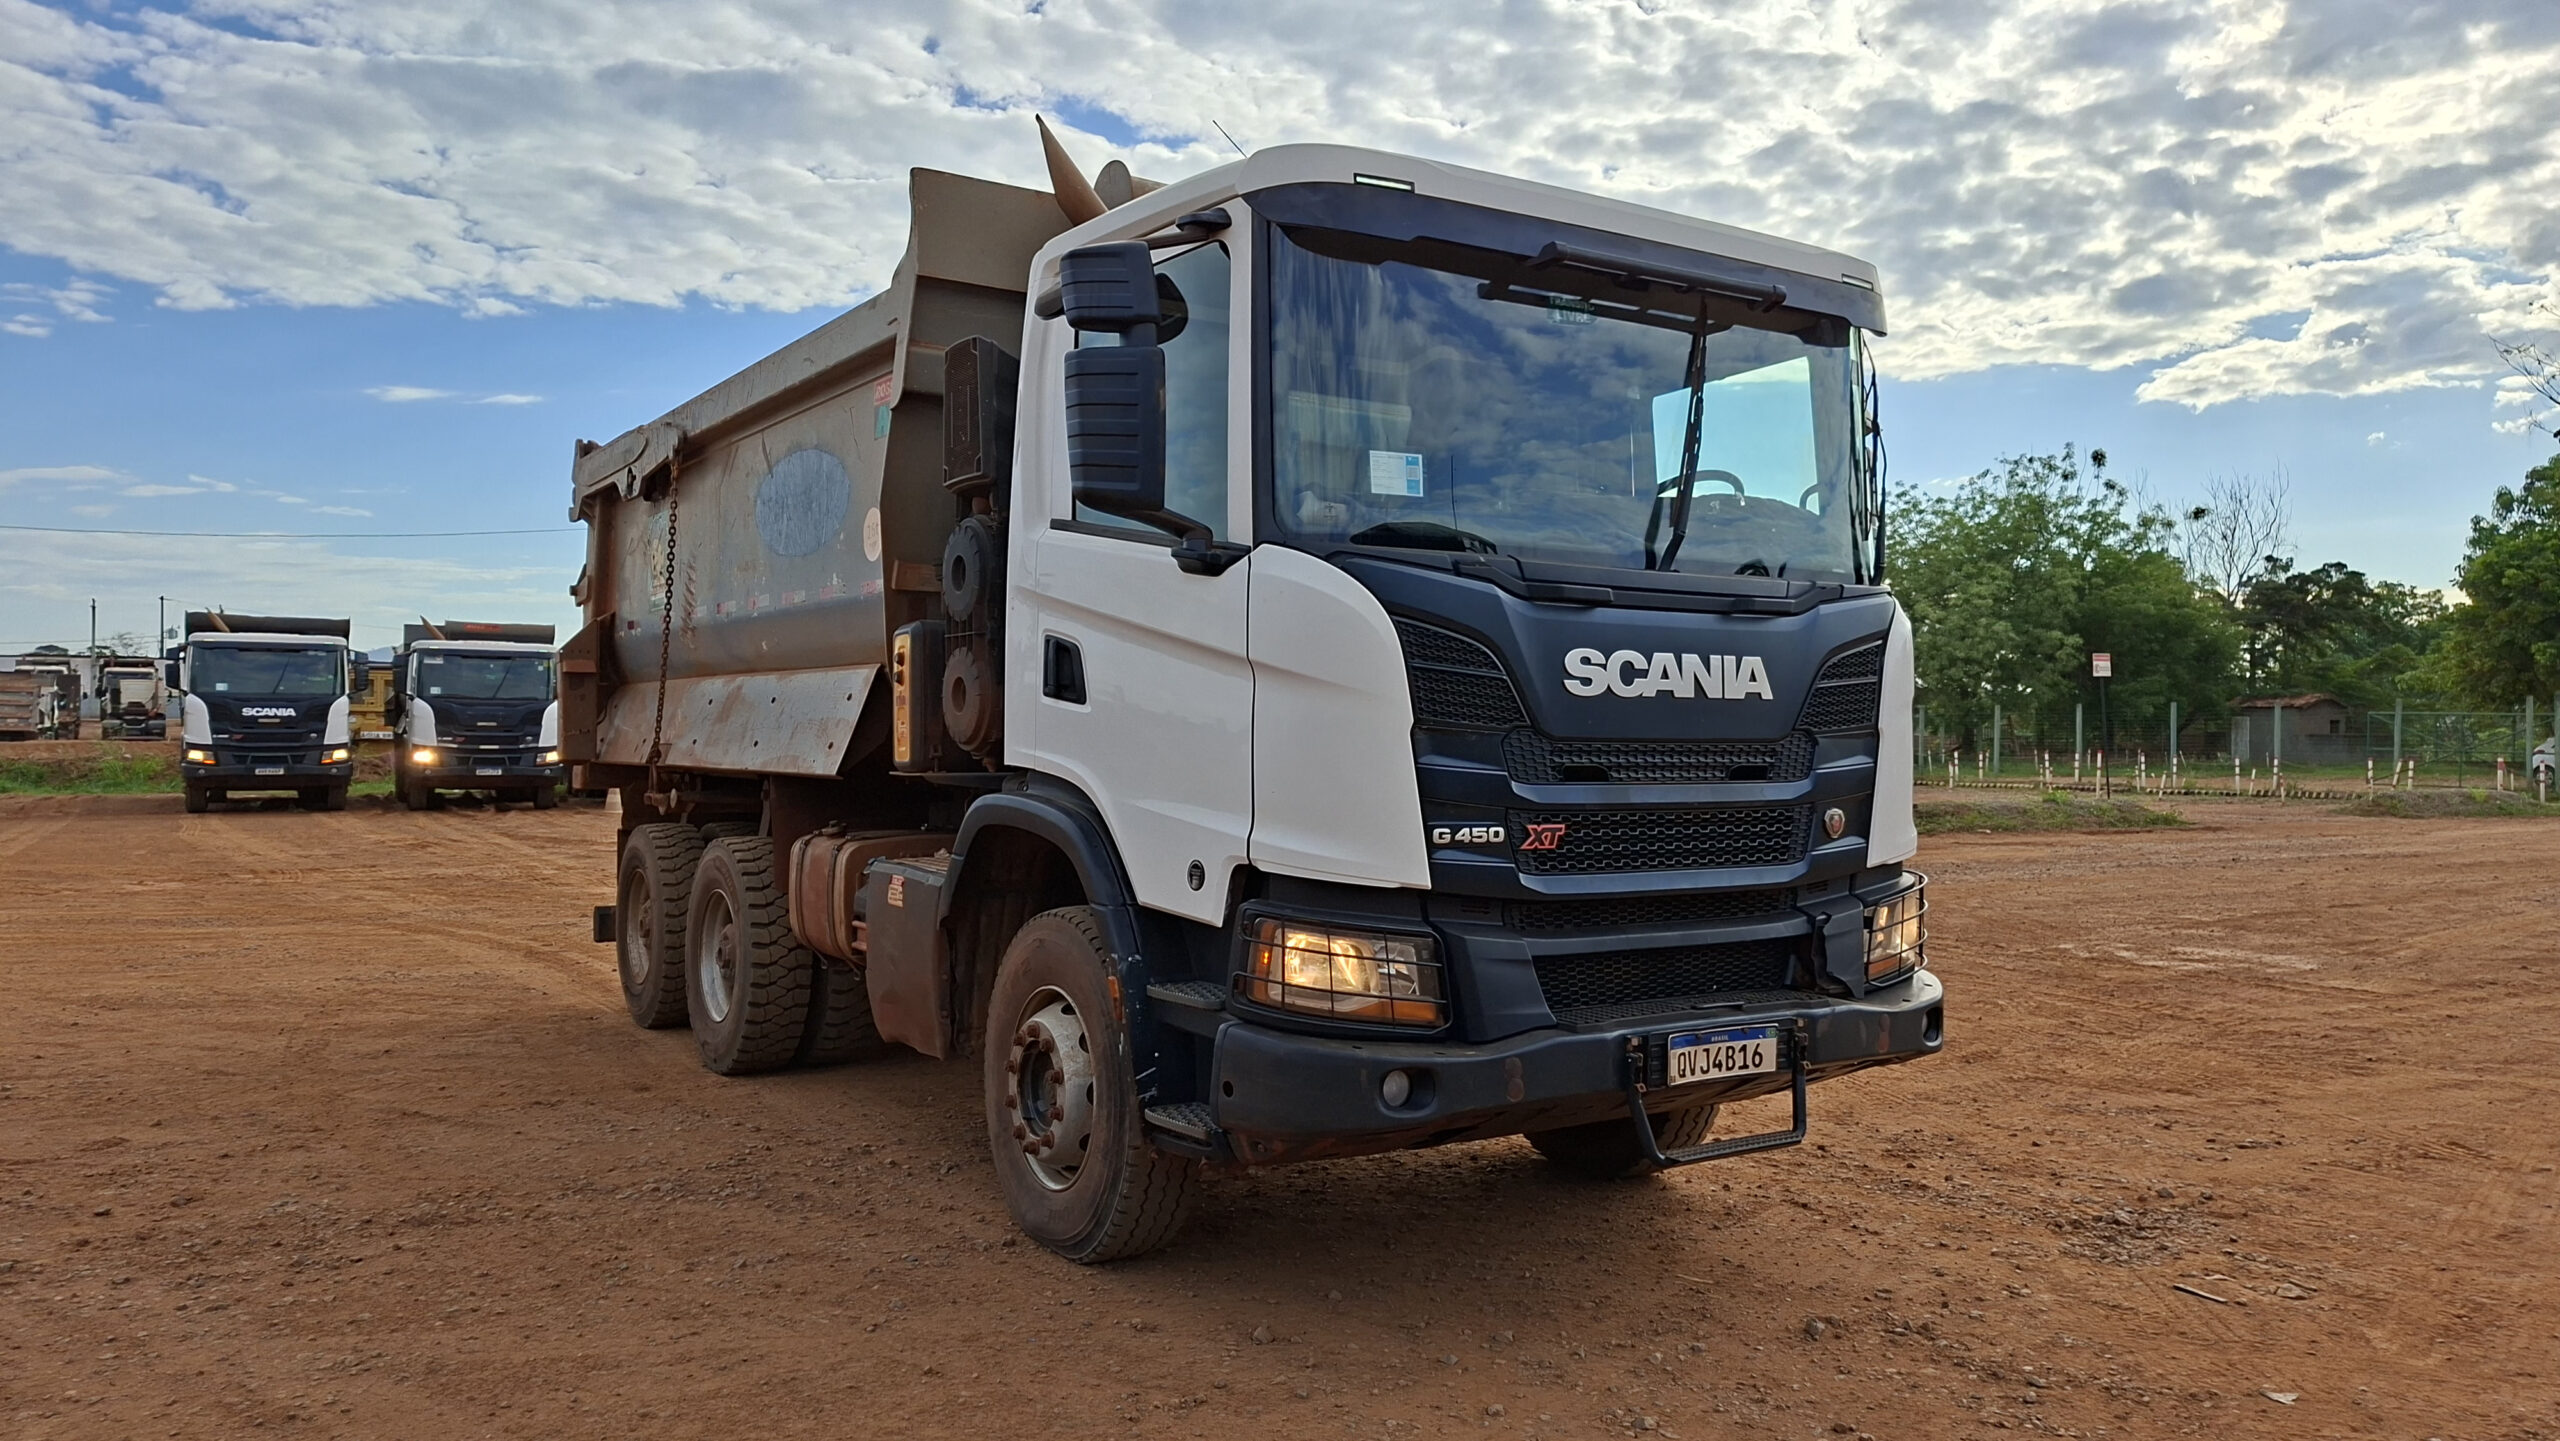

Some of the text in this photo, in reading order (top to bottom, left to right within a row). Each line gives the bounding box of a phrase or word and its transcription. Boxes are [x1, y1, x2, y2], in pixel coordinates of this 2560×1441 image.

[1562, 647, 1774, 701] SCANIA
[241, 706, 297, 717] SCANIA
[1432, 826, 1505, 844] G 450
[1520, 823, 1566, 850] XT
[1677, 1042, 1763, 1079] QVJ4B16
